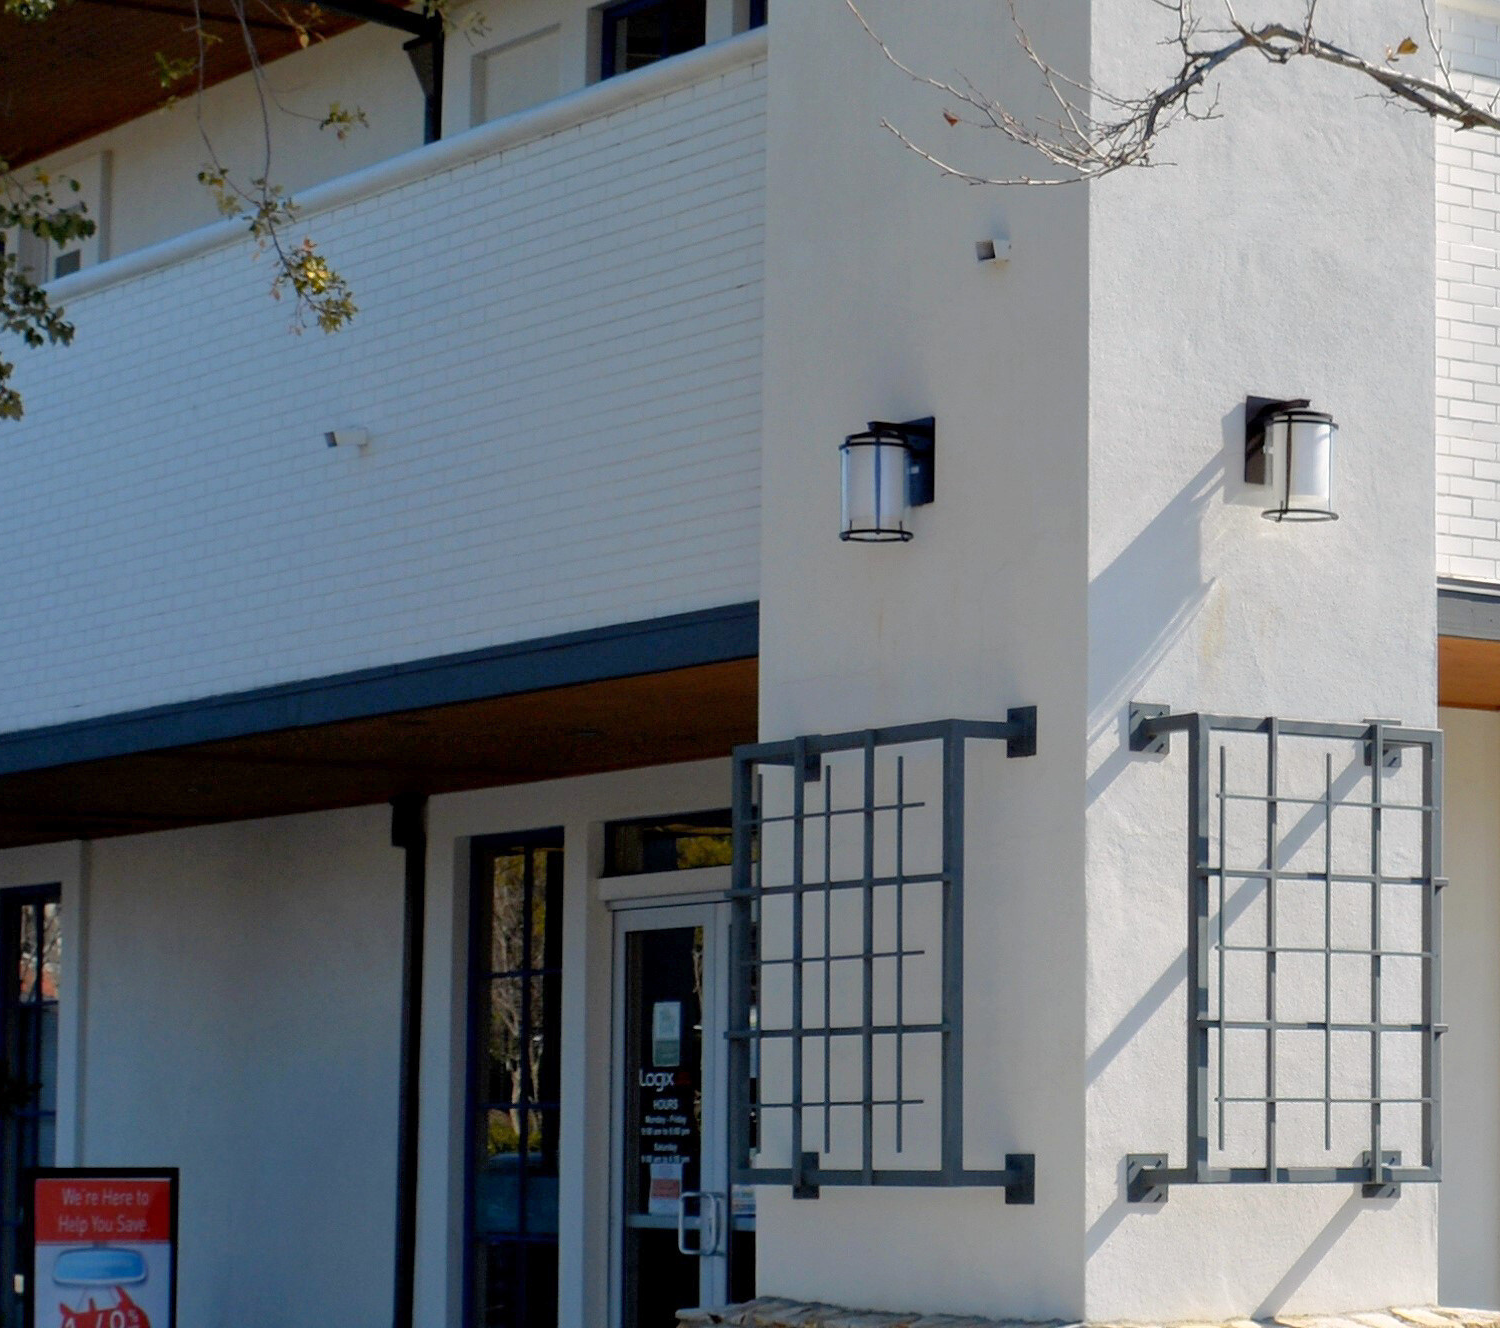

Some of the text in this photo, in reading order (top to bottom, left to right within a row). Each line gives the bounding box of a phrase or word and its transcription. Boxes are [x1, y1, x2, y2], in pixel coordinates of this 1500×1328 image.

[61, 1188, 150, 1206] We're Here to
[58, 1214, 150, 1237] Help You Save.
